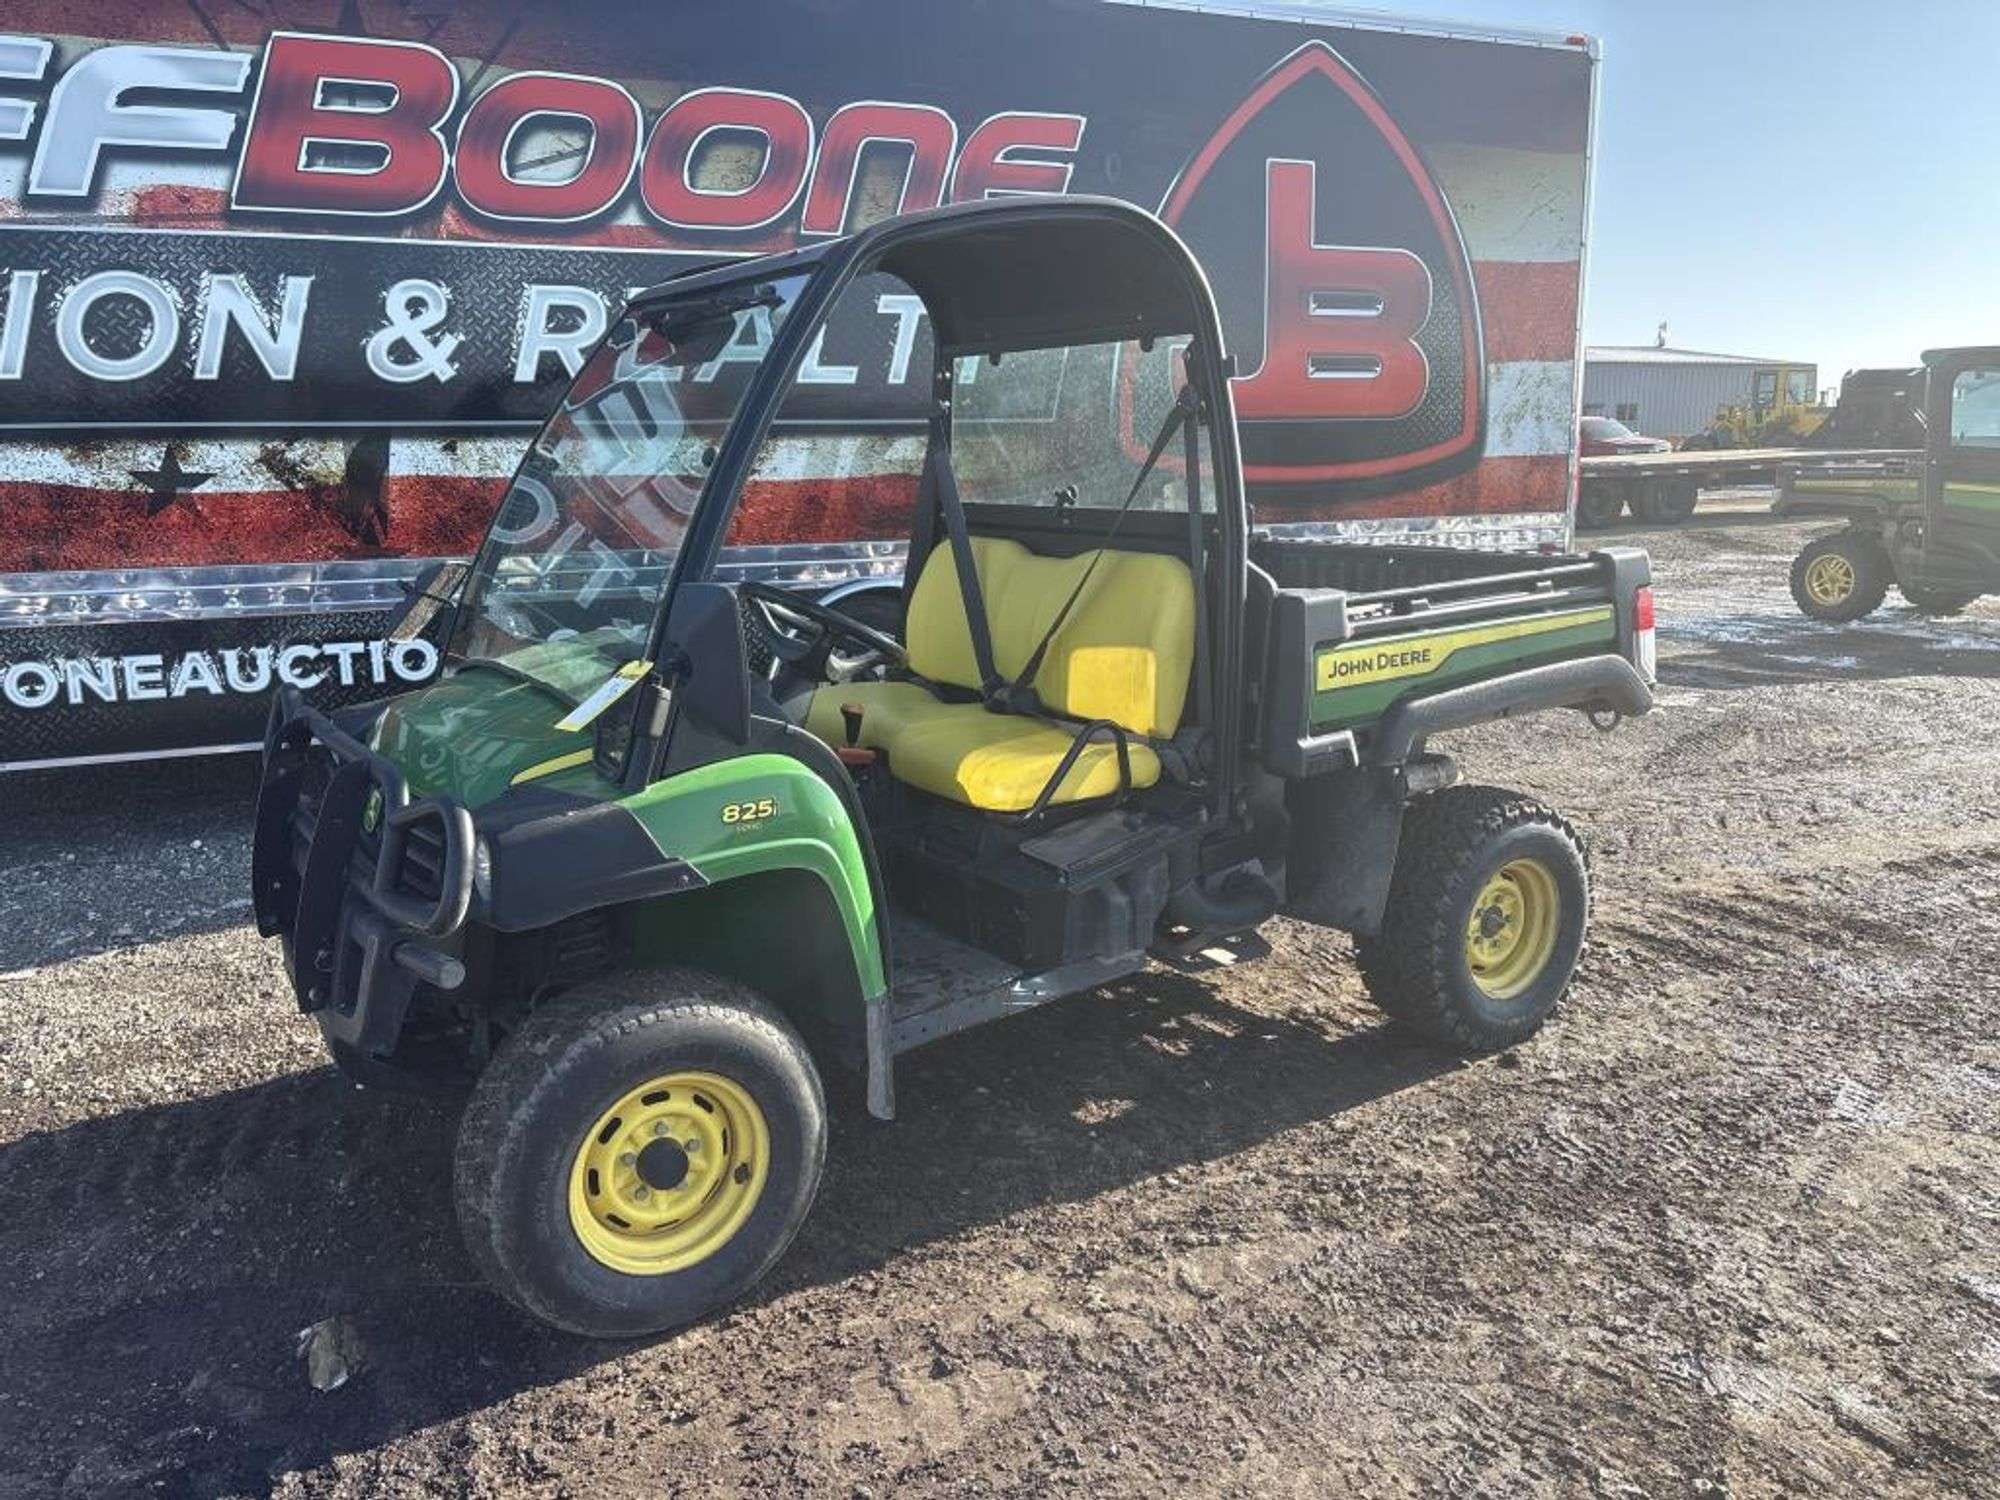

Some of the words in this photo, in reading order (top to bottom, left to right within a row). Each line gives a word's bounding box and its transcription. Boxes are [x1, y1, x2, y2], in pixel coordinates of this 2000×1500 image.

[364, 279, 460, 383] &
[1328, 659, 1373, 679] JOHN
[1377, 648, 1431, 670] DEERE
